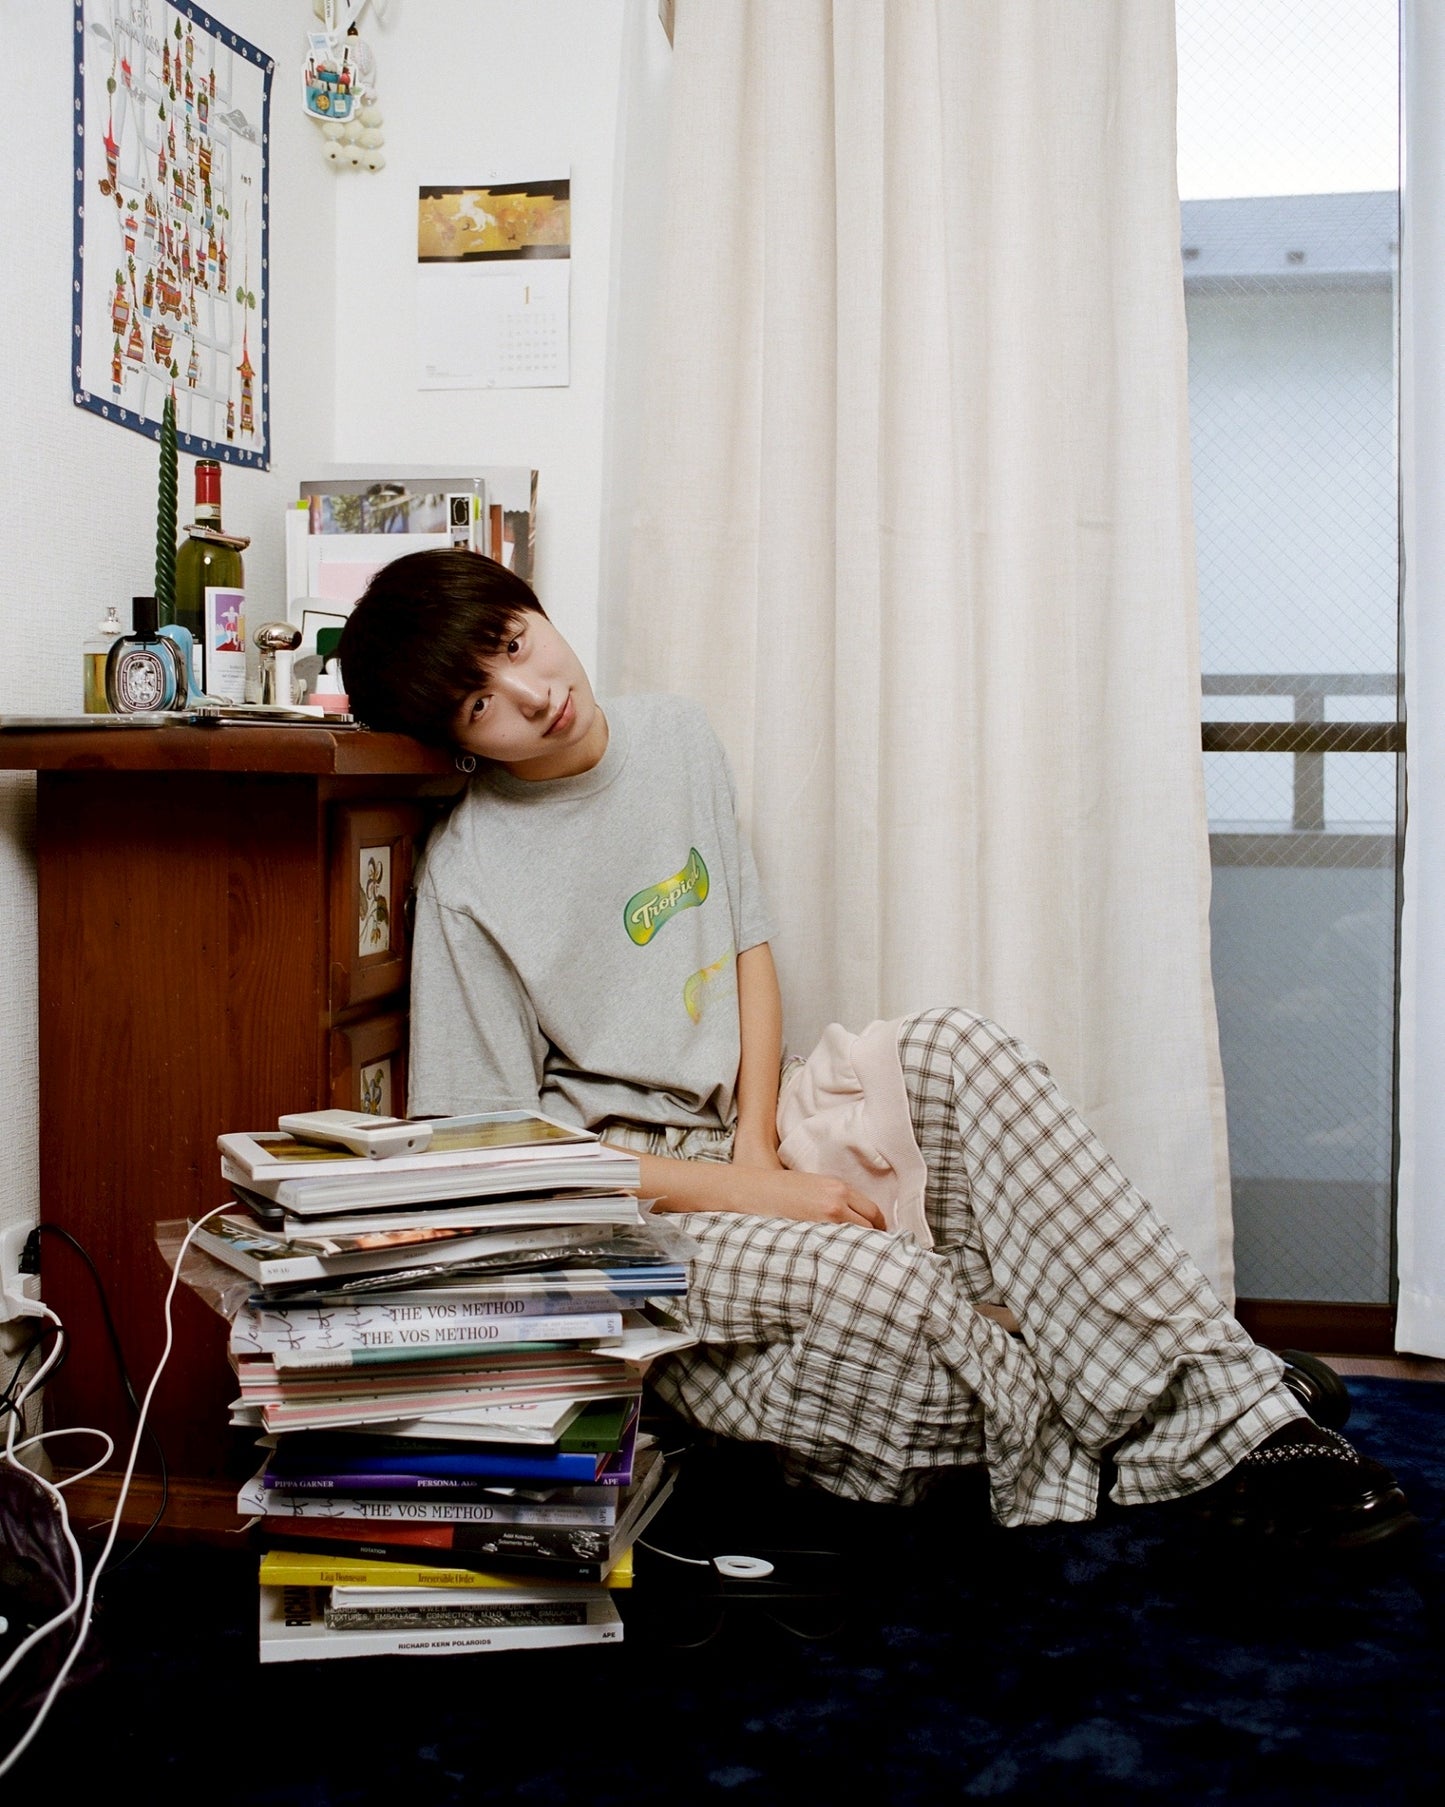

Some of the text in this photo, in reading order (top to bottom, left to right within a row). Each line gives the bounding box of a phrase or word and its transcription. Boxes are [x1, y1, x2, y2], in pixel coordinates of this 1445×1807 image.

[390, 1301, 525, 1322] THE VOS METHOD
[361, 1326, 499, 1346] THE VOS METHOD
[581, 1441, 598, 1449] APE
[274, 1480, 298, 1488] PIPPA
[300, 1480, 334, 1488] GARNER
[417, 1479, 460, 1487] PERSONAL
[603, 1477, 619, 1486] APE
[362, 1503, 494, 1520] THE VOS METHOD
[431, 1640, 450, 1648] KERN
[452, 1638, 492, 1647] POLAROIDS
